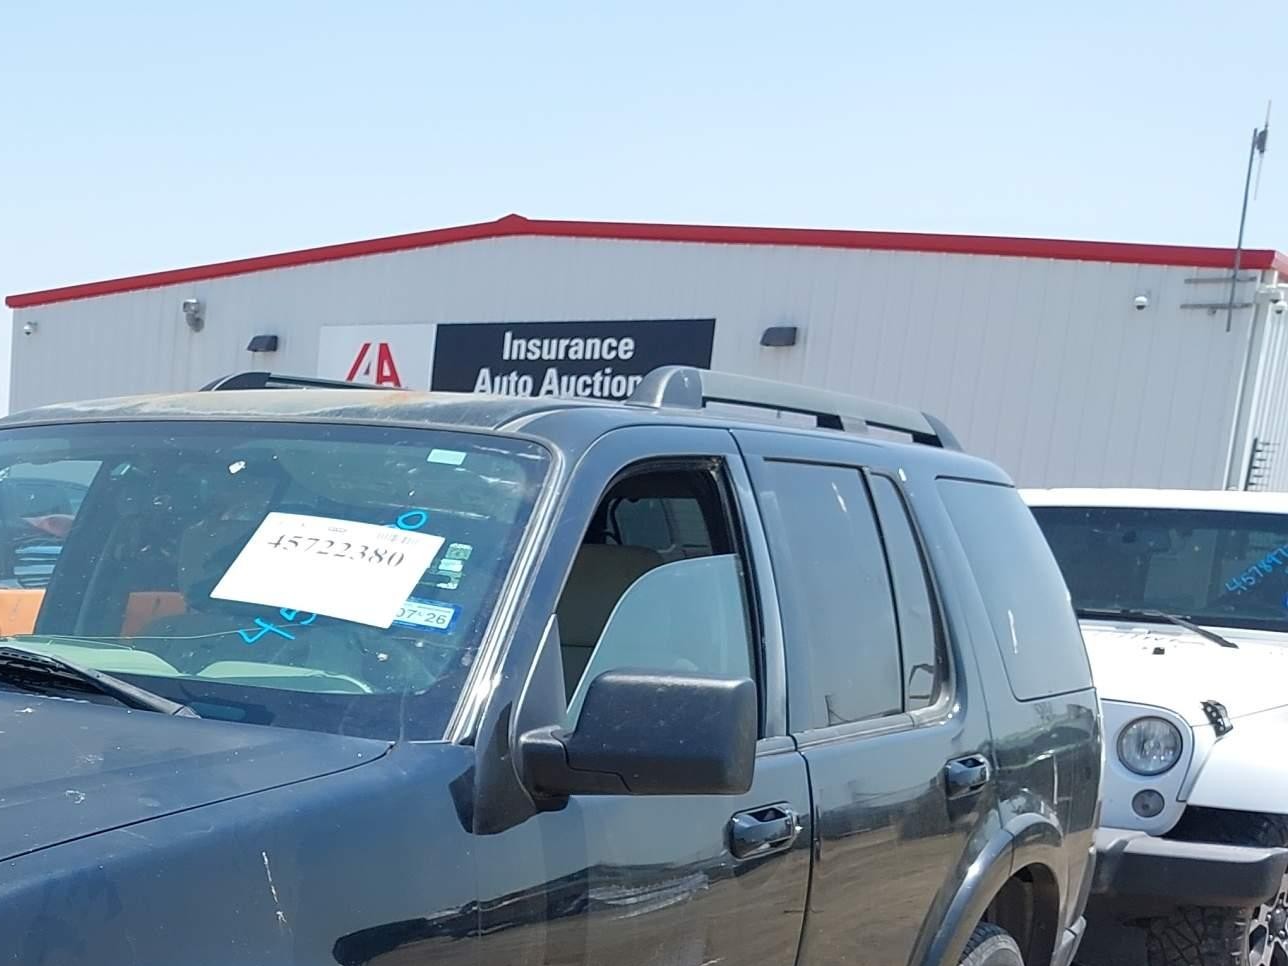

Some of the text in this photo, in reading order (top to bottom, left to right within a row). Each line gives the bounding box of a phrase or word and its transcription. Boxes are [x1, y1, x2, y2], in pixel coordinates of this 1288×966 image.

[502, 330, 635, 361] Insurance
[473, 367, 534, 396] Auto
[268, 535, 404, 567] 45722380
[423, 611, 448, 625] 26
